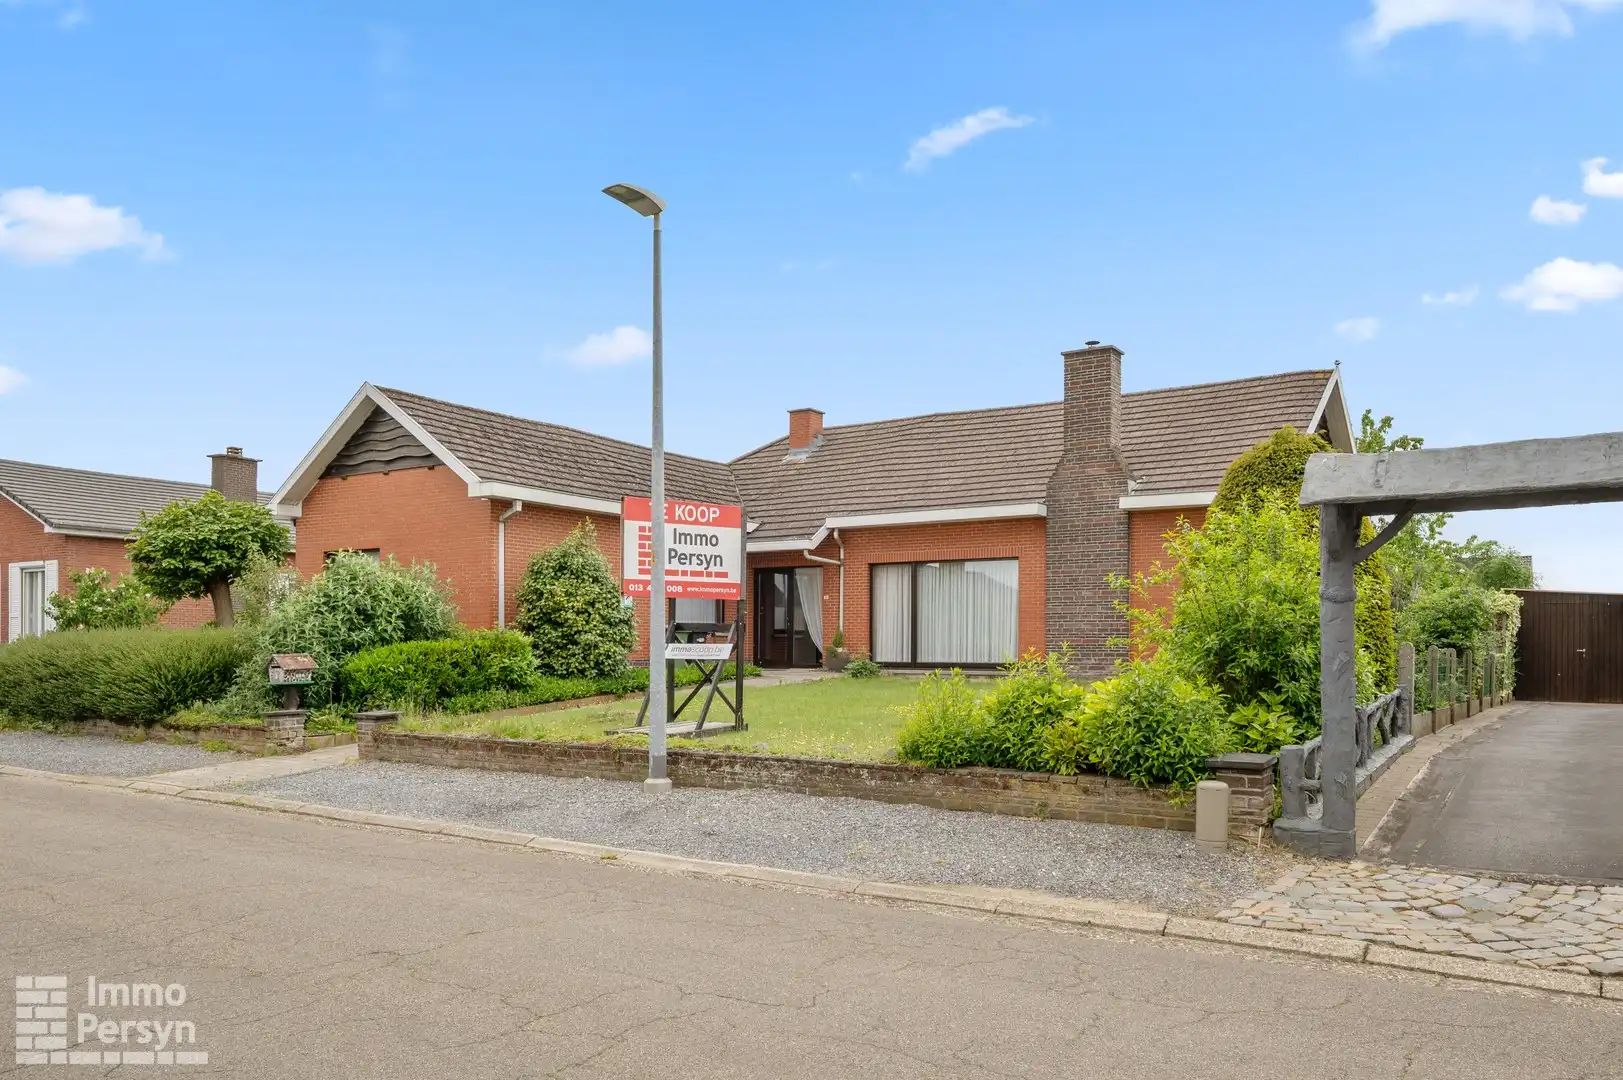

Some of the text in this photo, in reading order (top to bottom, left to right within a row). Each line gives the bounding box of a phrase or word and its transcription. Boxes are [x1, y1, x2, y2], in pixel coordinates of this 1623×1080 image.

[674, 504, 720, 523] KOOP
[673, 527, 719, 547] Immo
[668, 547, 724, 571] Persyn
[628, 583, 644, 592] 013
[666, 585, 683, 593] 008
